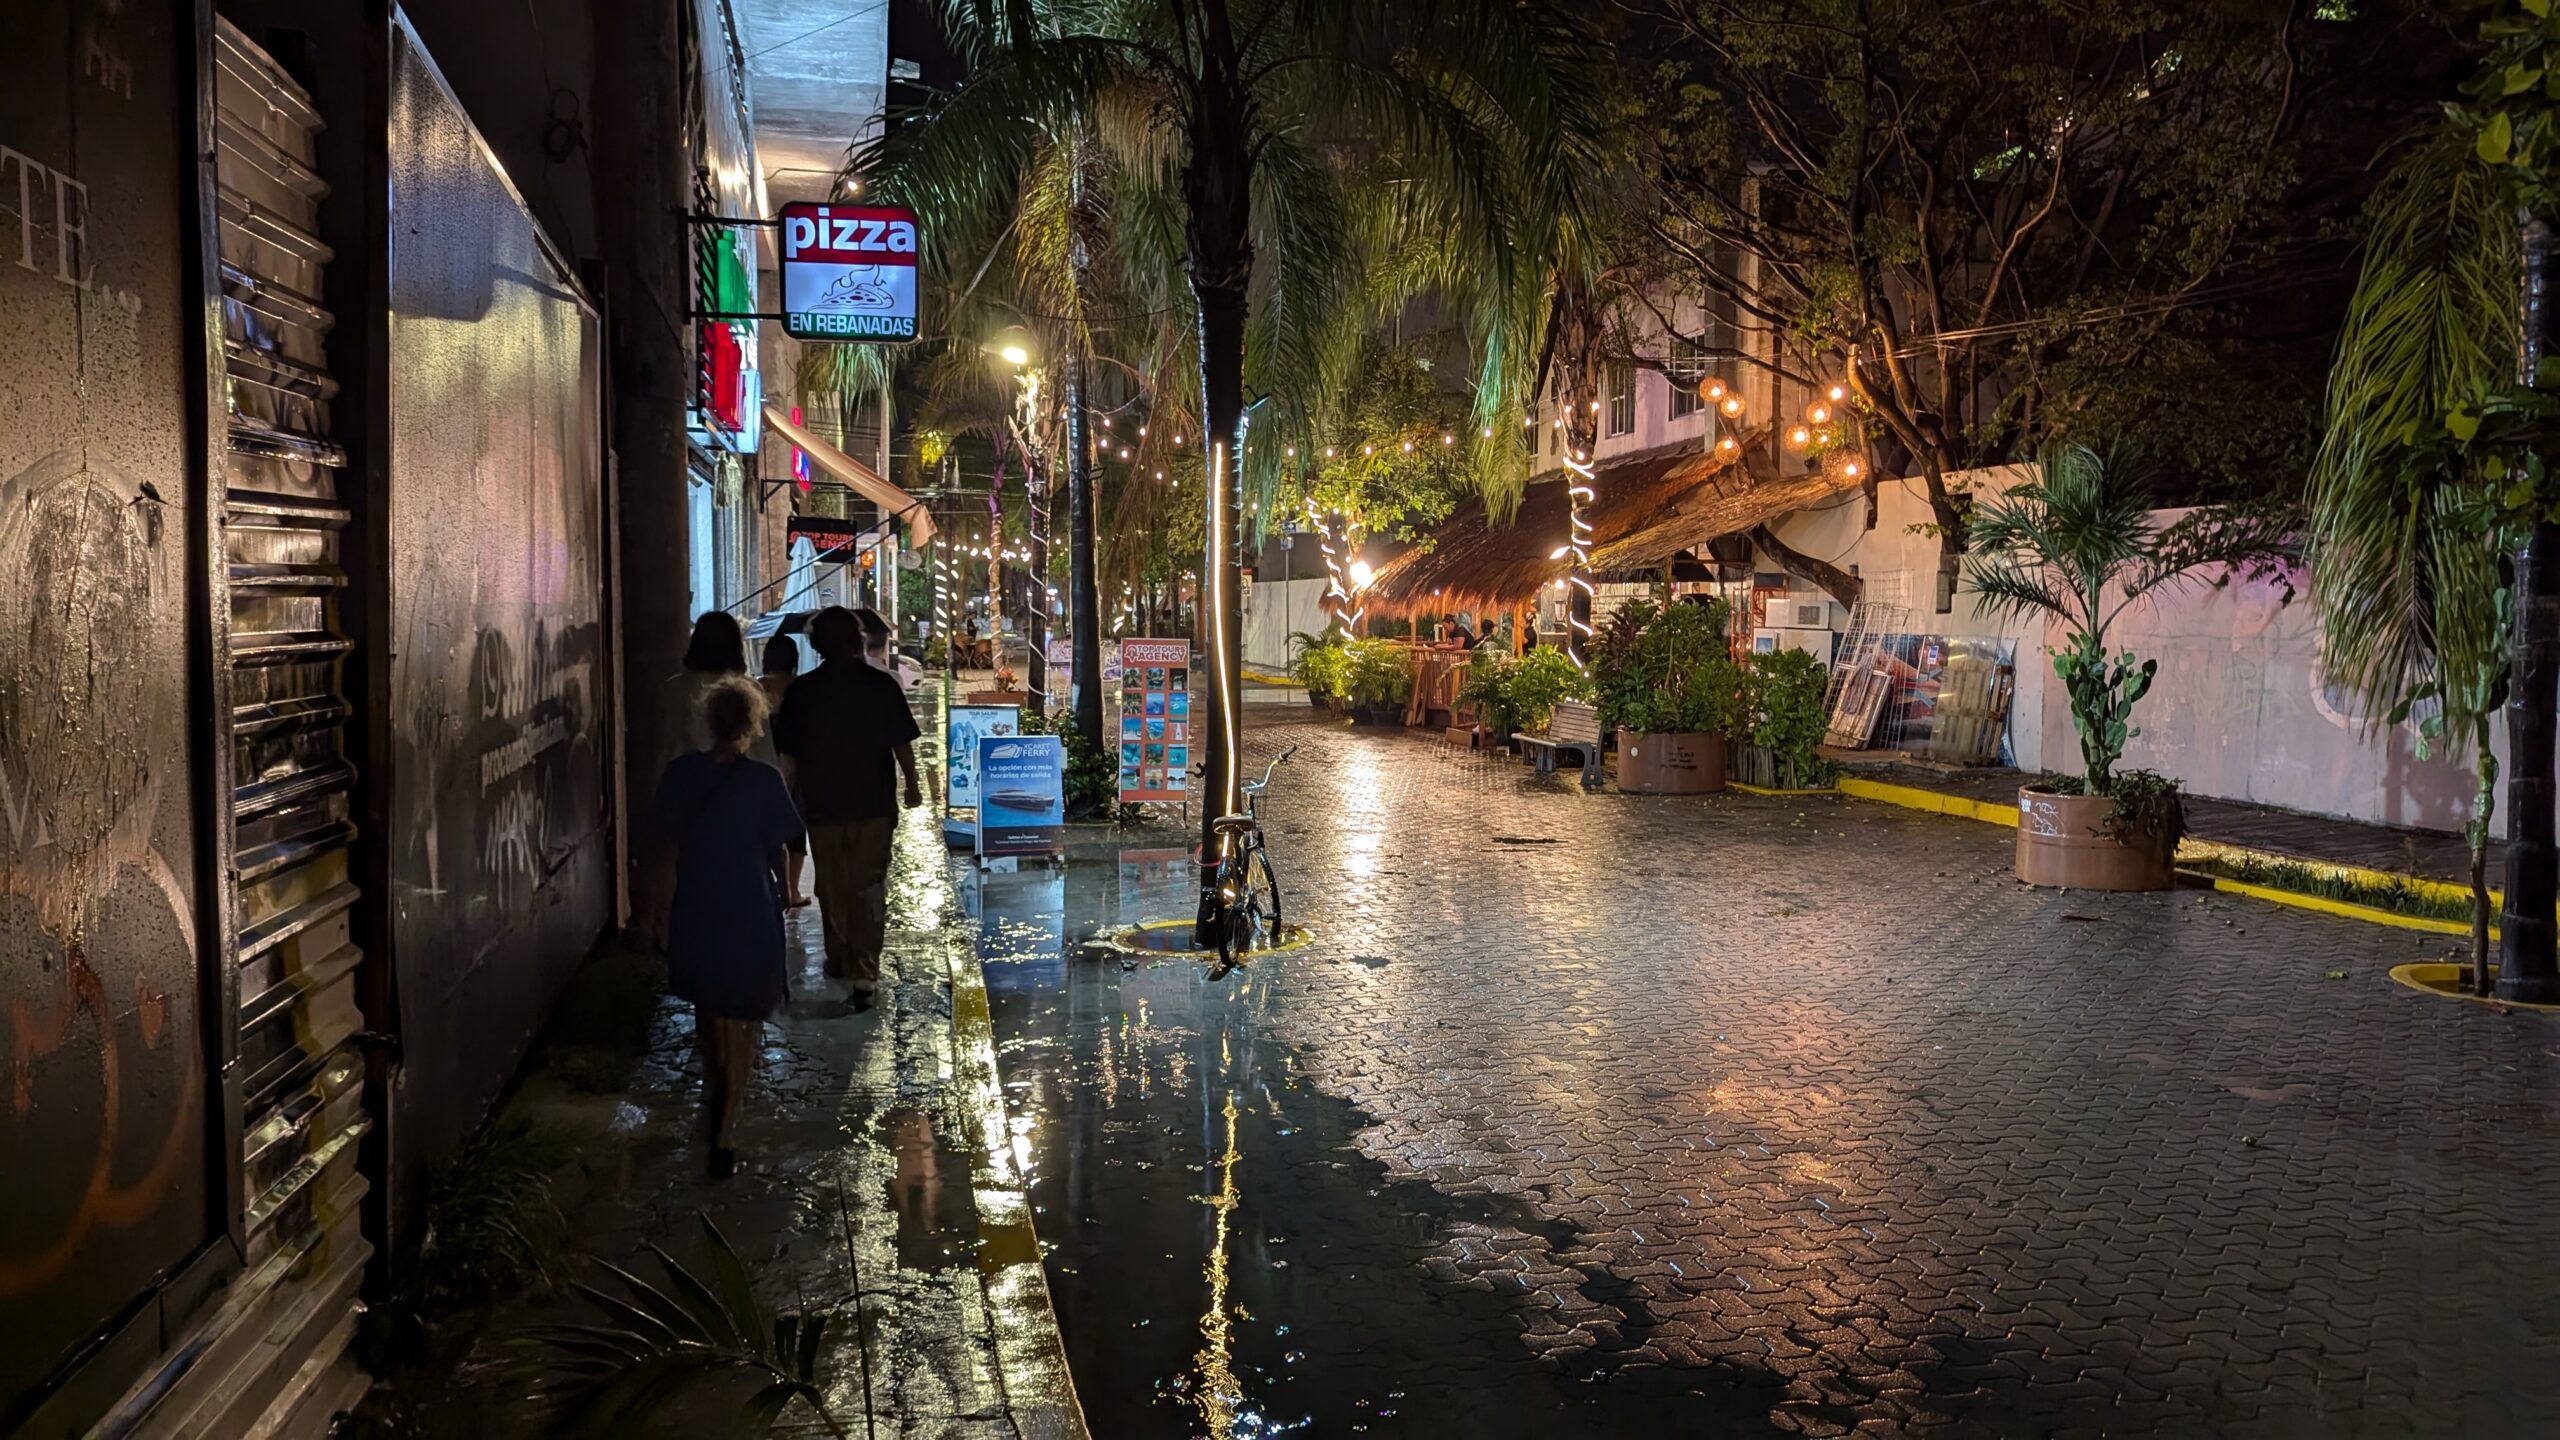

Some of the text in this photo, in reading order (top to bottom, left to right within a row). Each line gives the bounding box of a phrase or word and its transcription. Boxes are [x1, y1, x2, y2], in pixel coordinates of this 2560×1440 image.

[785, 207, 916, 258] pizza
[790, 313, 914, 336] EN REBANADAS
[1138, 645, 1186, 653] TOP TOURS
[1138, 652, 1185, 661] AGENCY
[1022, 749, 1051, 757] FERRY
[998, 764, 1022, 772] opción
